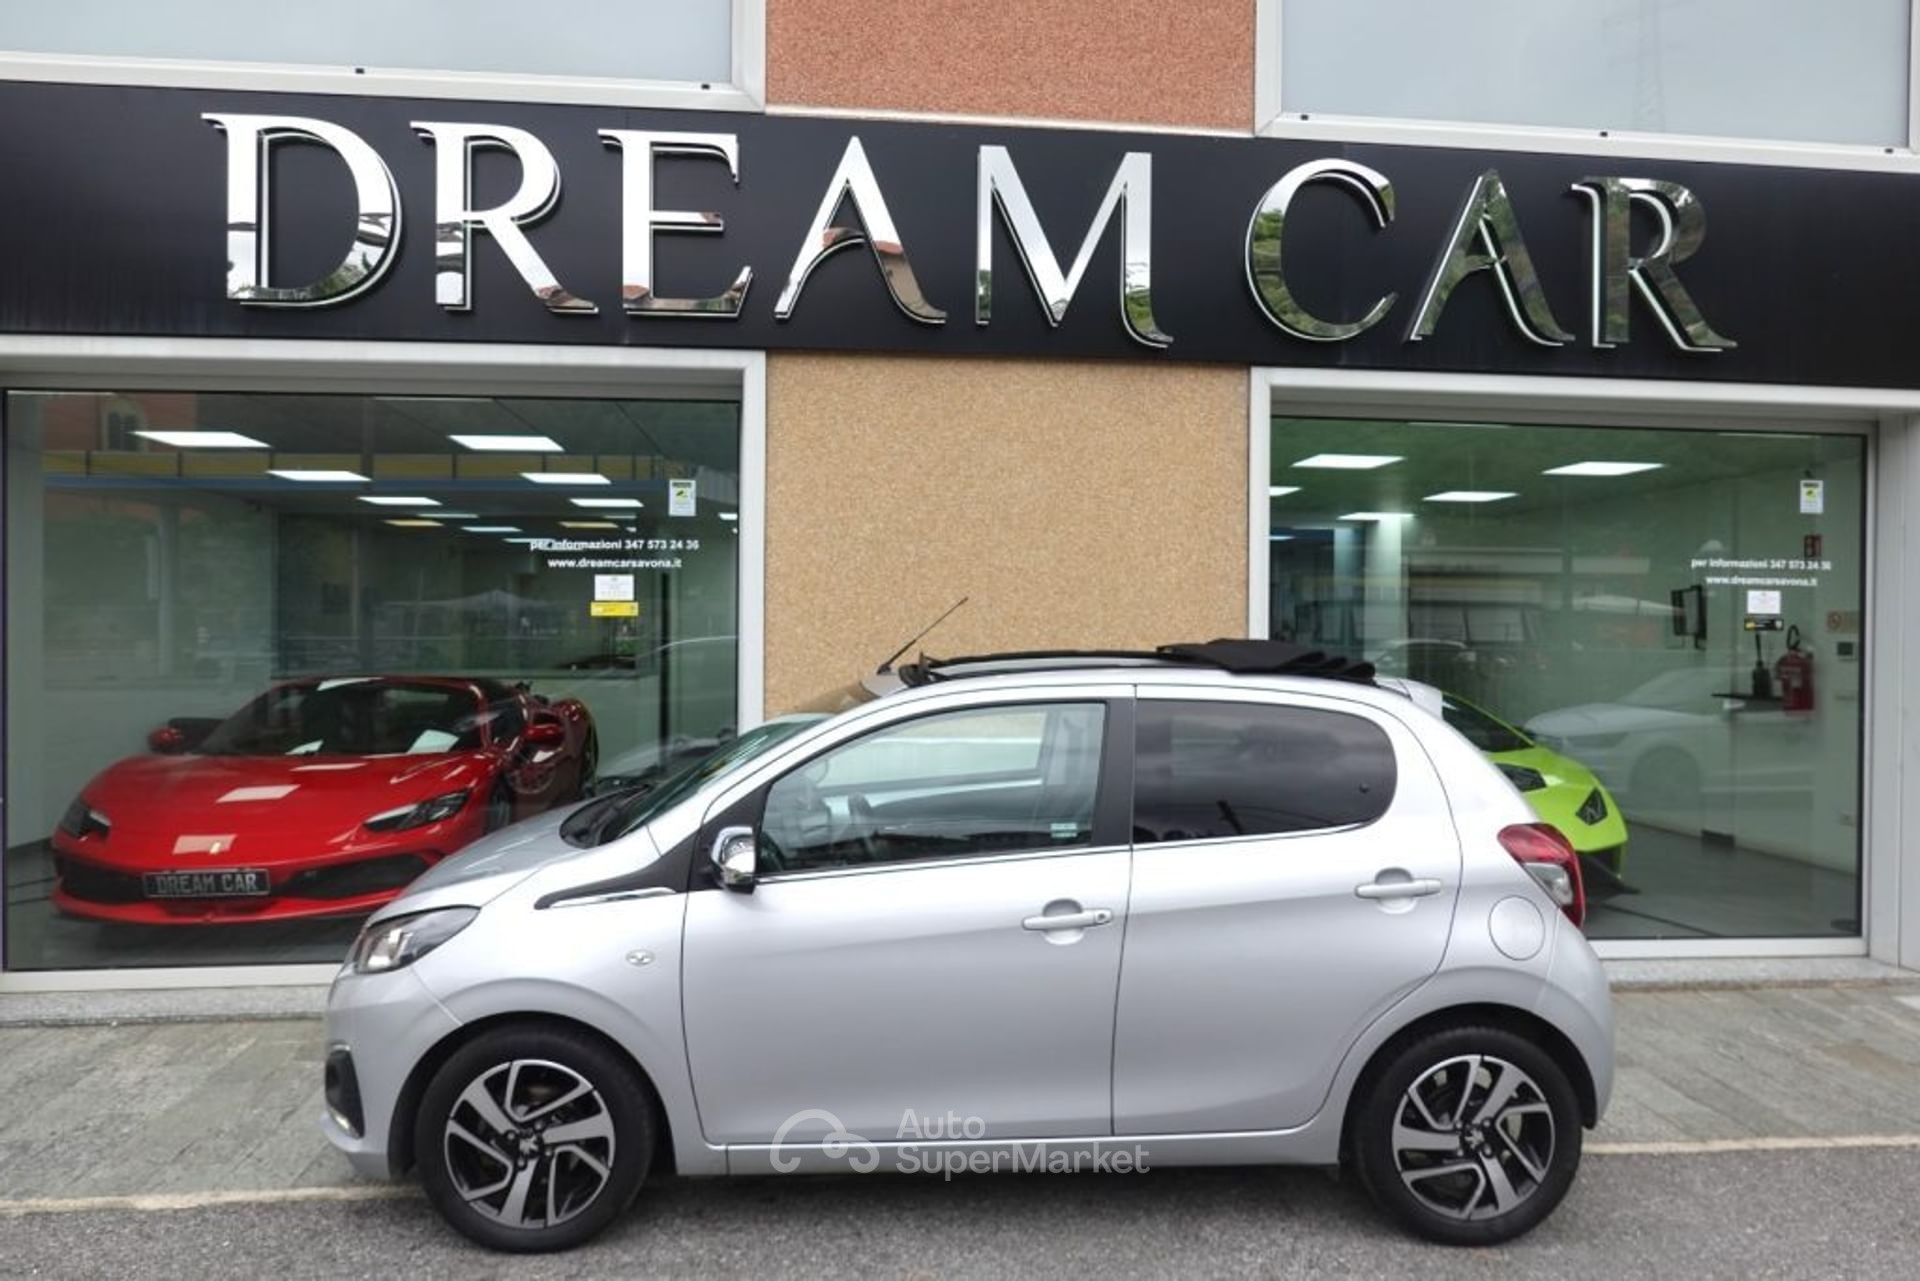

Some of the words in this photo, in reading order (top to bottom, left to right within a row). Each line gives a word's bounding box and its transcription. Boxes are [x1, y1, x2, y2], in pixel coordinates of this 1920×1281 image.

[202, 112, 1173, 348] DREAM
[1244, 158, 1738, 352] CAR
[551, 539, 622, 550] informazioni
[624, 540, 644, 550] 347
[647, 540, 667, 550] 573
[670, 540, 683, 550] 24
[547, 557, 682, 569] www.dreamcarsavona.it
[1705, 576, 1818, 587] www.dreamcarsavona.it
[155, 873, 215, 894] DREAM
[221, 872, 257, 892] CAR
